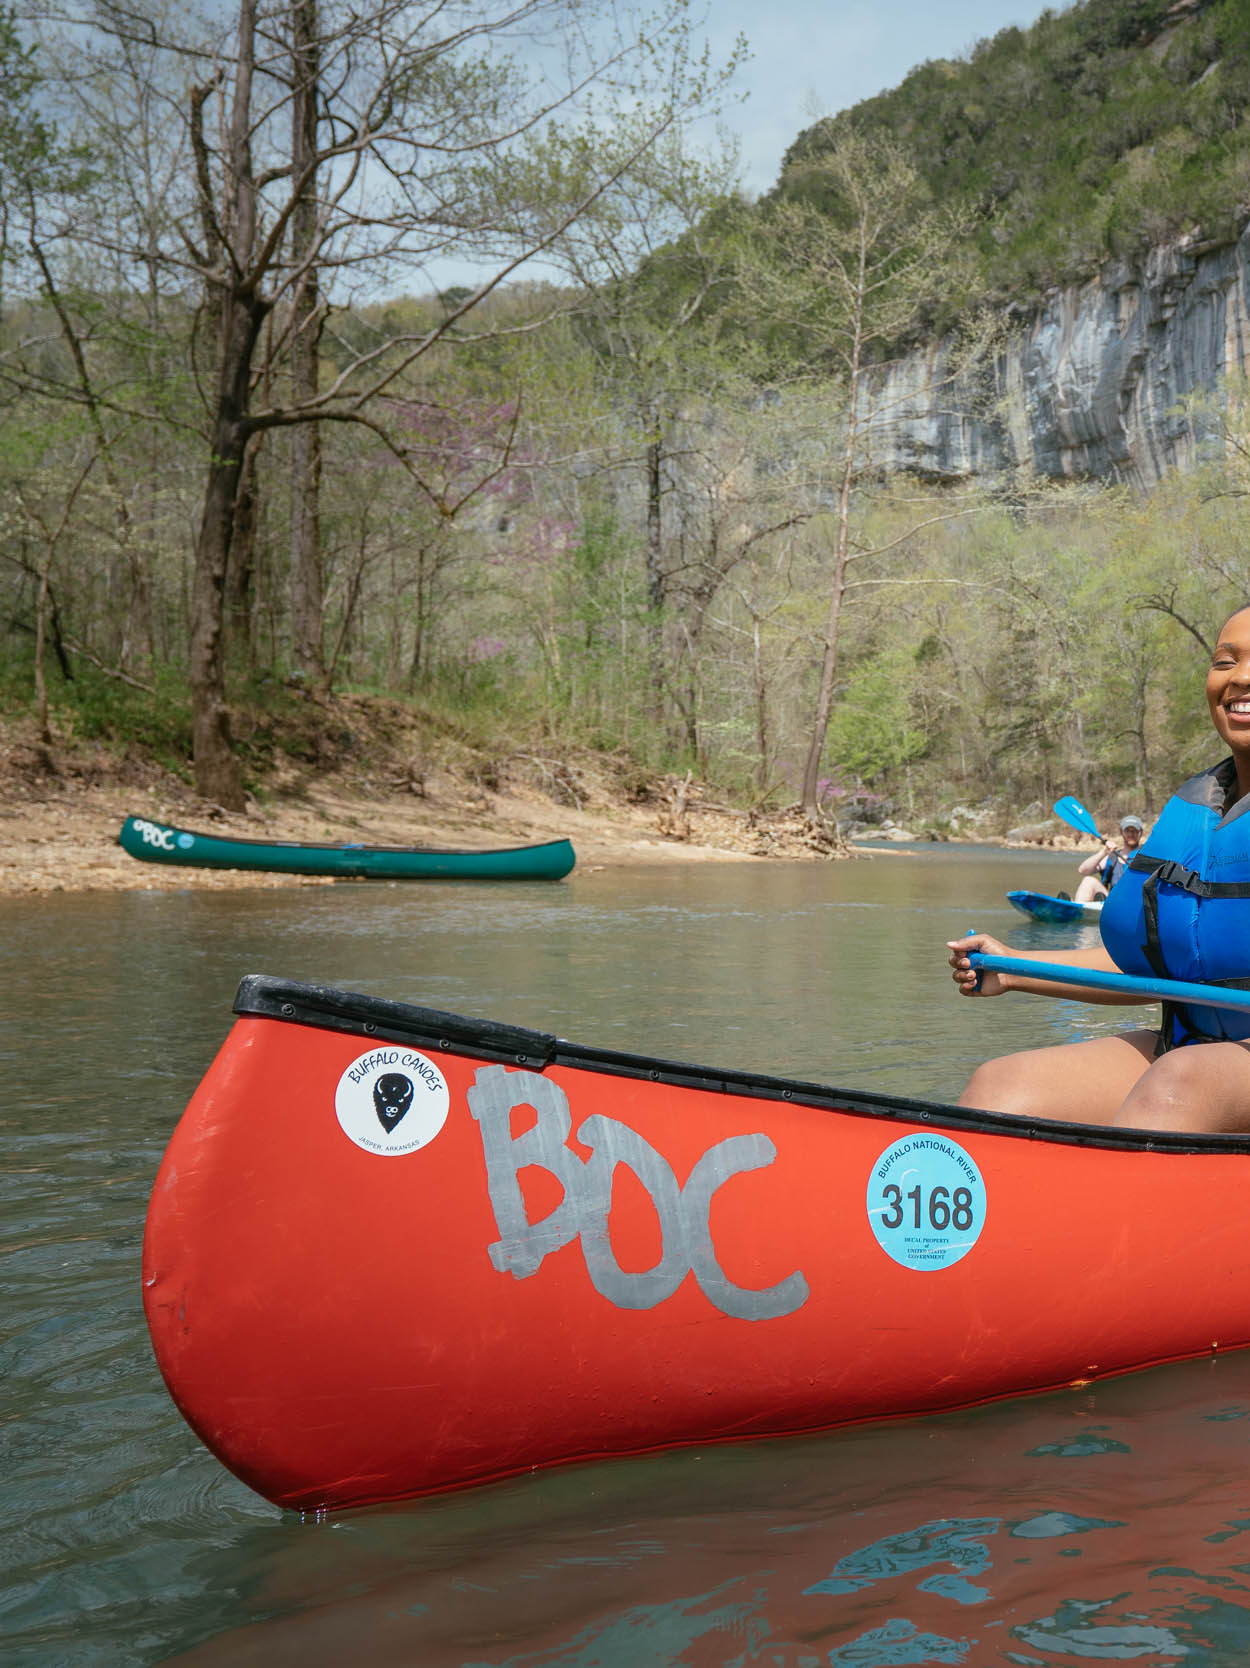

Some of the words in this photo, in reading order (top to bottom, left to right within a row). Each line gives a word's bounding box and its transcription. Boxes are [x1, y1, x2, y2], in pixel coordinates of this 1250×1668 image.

[143, 821, 176, 850] BOC
[348, 1051, 399, 1084] BUFFALO
[402, 1054, 443, 1092] CANOES
[358, 1135, 384, 1151] JASPER,
[385, 1139, 420, 1152] ARKANSAS
[878, 1144, 911, 1179] BUFFALO
[912, 1140, 956, 1160] NATIONAL
[956, 1156, 977, 1184] RIVER
[466, 1064, 811, 1321] BOC
[881, 1184, 974, 1231] 3168
